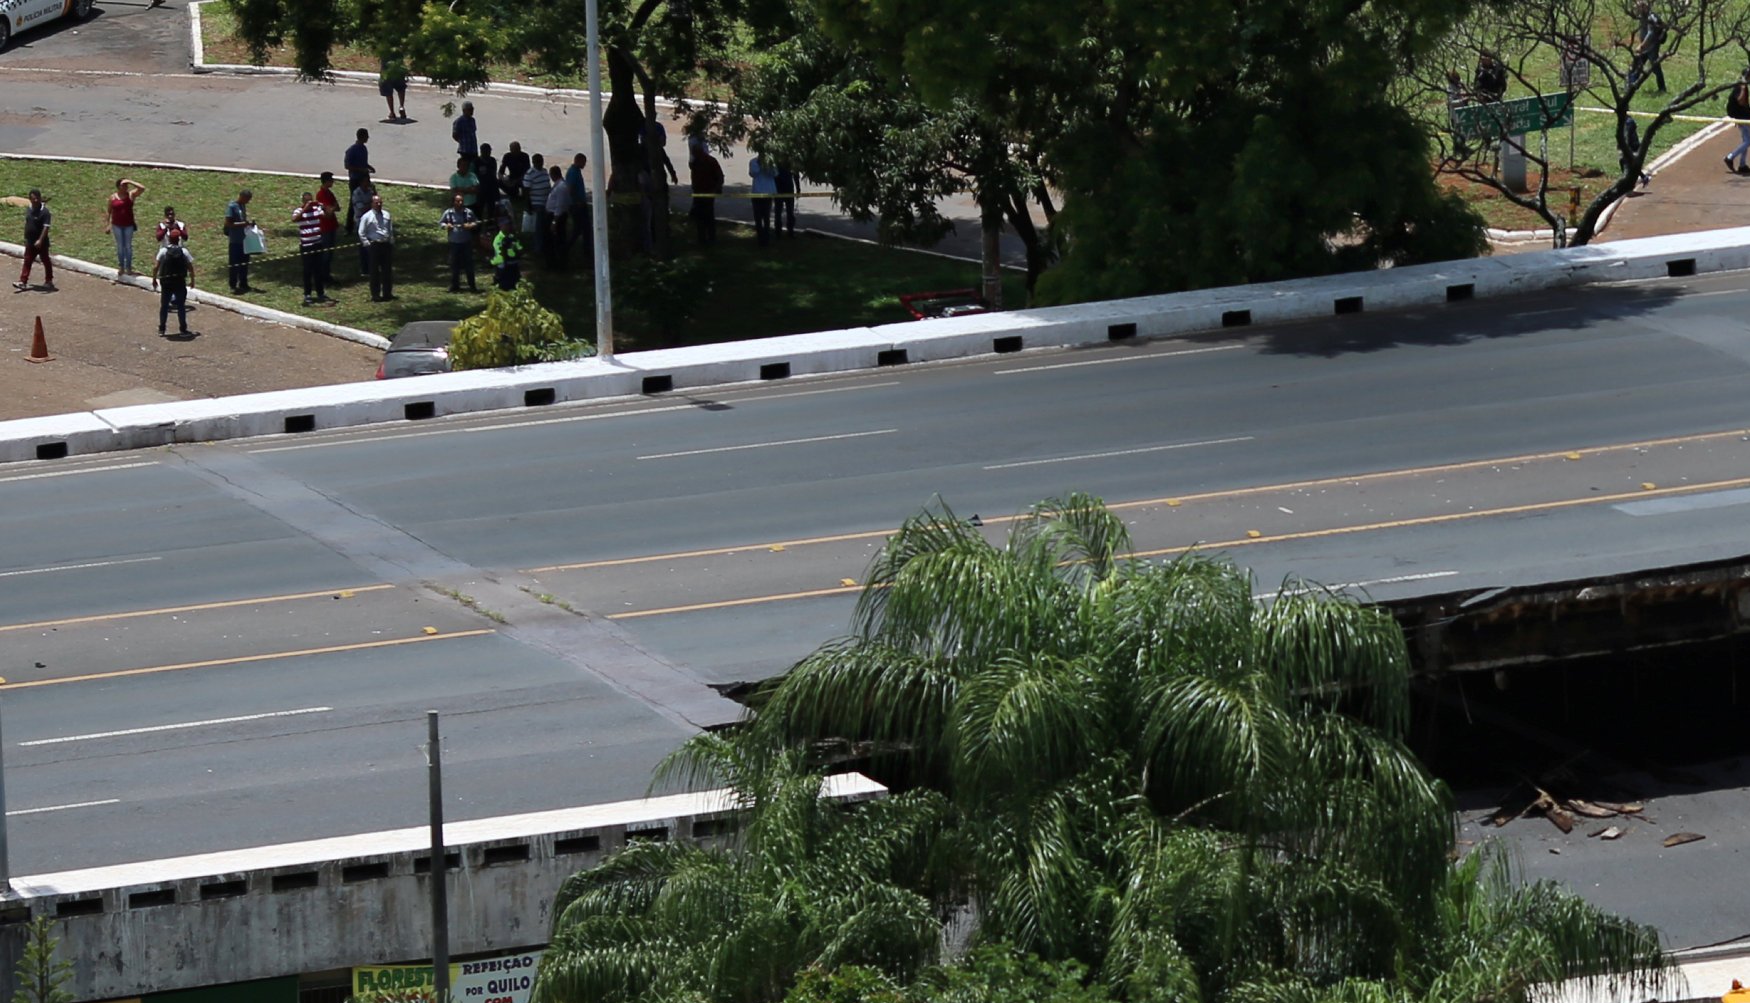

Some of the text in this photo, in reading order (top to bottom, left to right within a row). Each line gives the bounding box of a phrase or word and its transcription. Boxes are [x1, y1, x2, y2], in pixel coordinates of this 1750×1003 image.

[357, 967, 435, 993] FLOREST
[465, 976, 530, 996] POR QUILO
